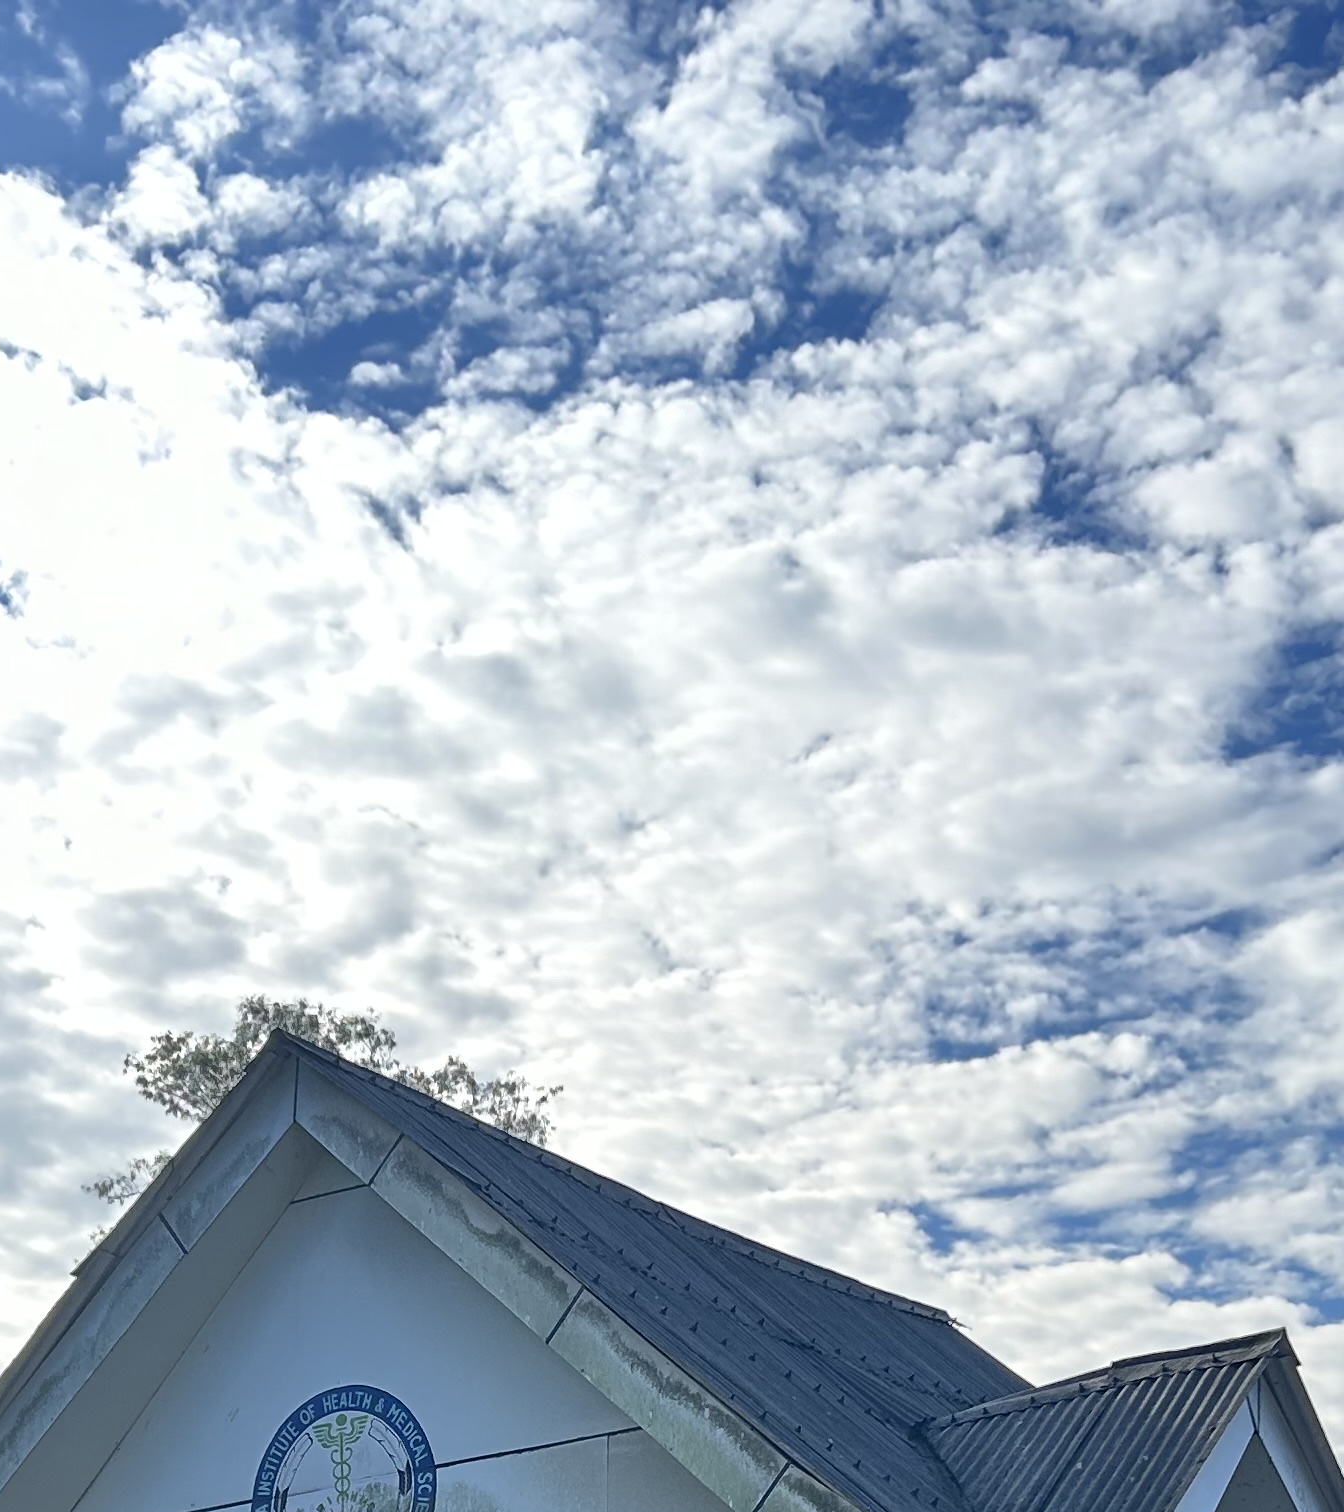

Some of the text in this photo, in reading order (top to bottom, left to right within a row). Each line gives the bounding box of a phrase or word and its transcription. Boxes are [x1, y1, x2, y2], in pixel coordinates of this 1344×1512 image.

[257, 1421, 300, 1496] INSTITUTE
[299, 1404, 317, 1424] OF
[322, 1391, 373, 1413] HEALTH
[374, 1397, 385, 1413] &
[386, 1403, 429, 1467] MEDICAL
